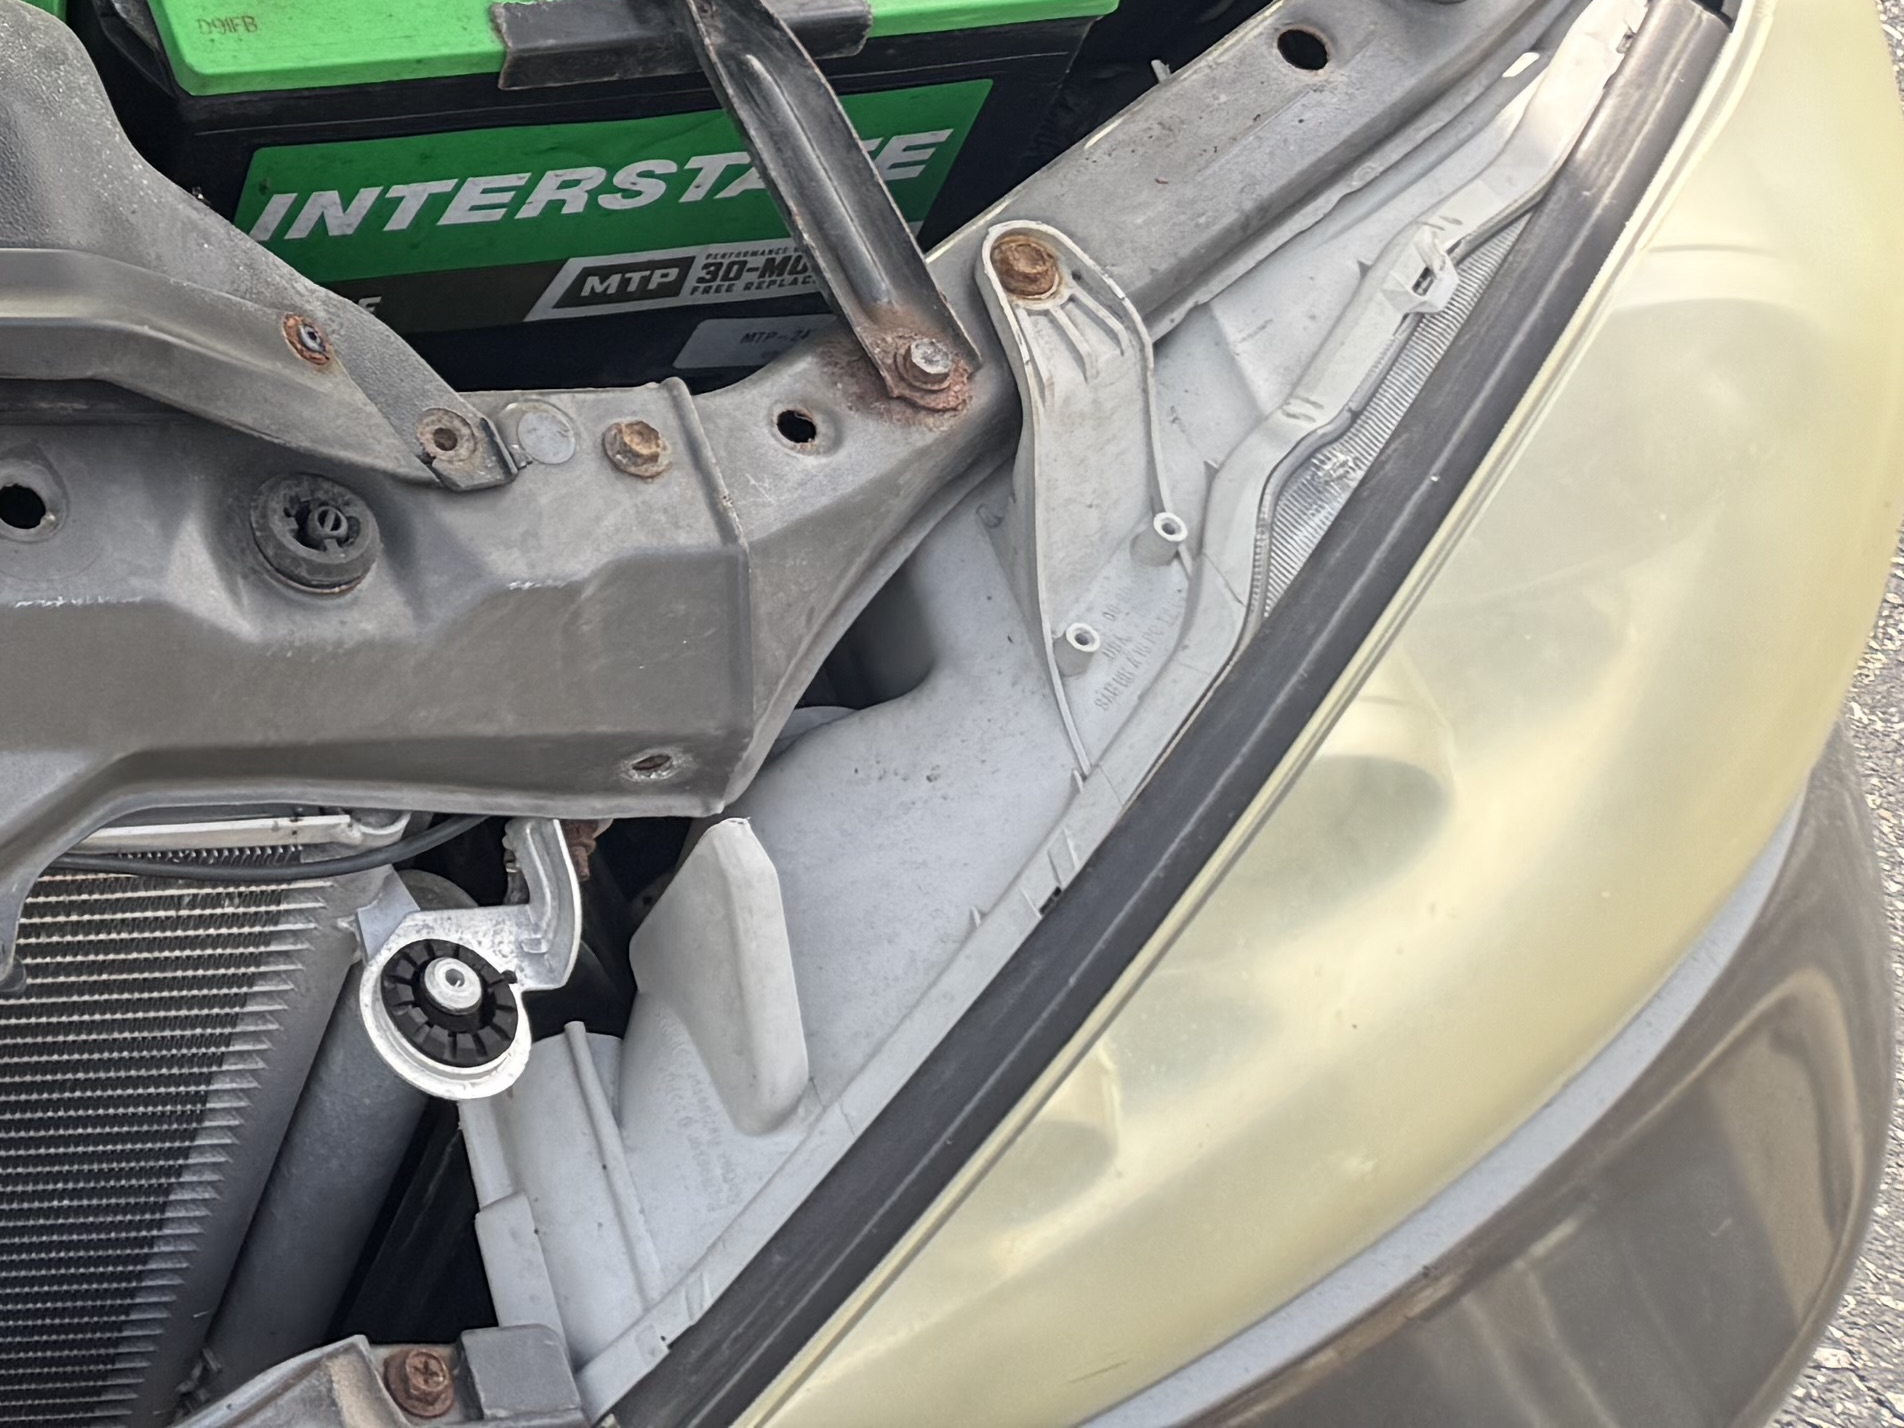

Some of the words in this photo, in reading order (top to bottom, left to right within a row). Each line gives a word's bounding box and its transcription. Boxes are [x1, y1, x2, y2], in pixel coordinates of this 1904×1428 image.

[250, 129, 954, 242] INTERSTAE
[705, 246, 791, 261] PERFORMANCE
[580, 267, 680, 297] MTP
[695, 254, 809, 284] 30-MO
[690, 283, 736, 296] FREE
[743, 275, 816, 291] REPLAC
